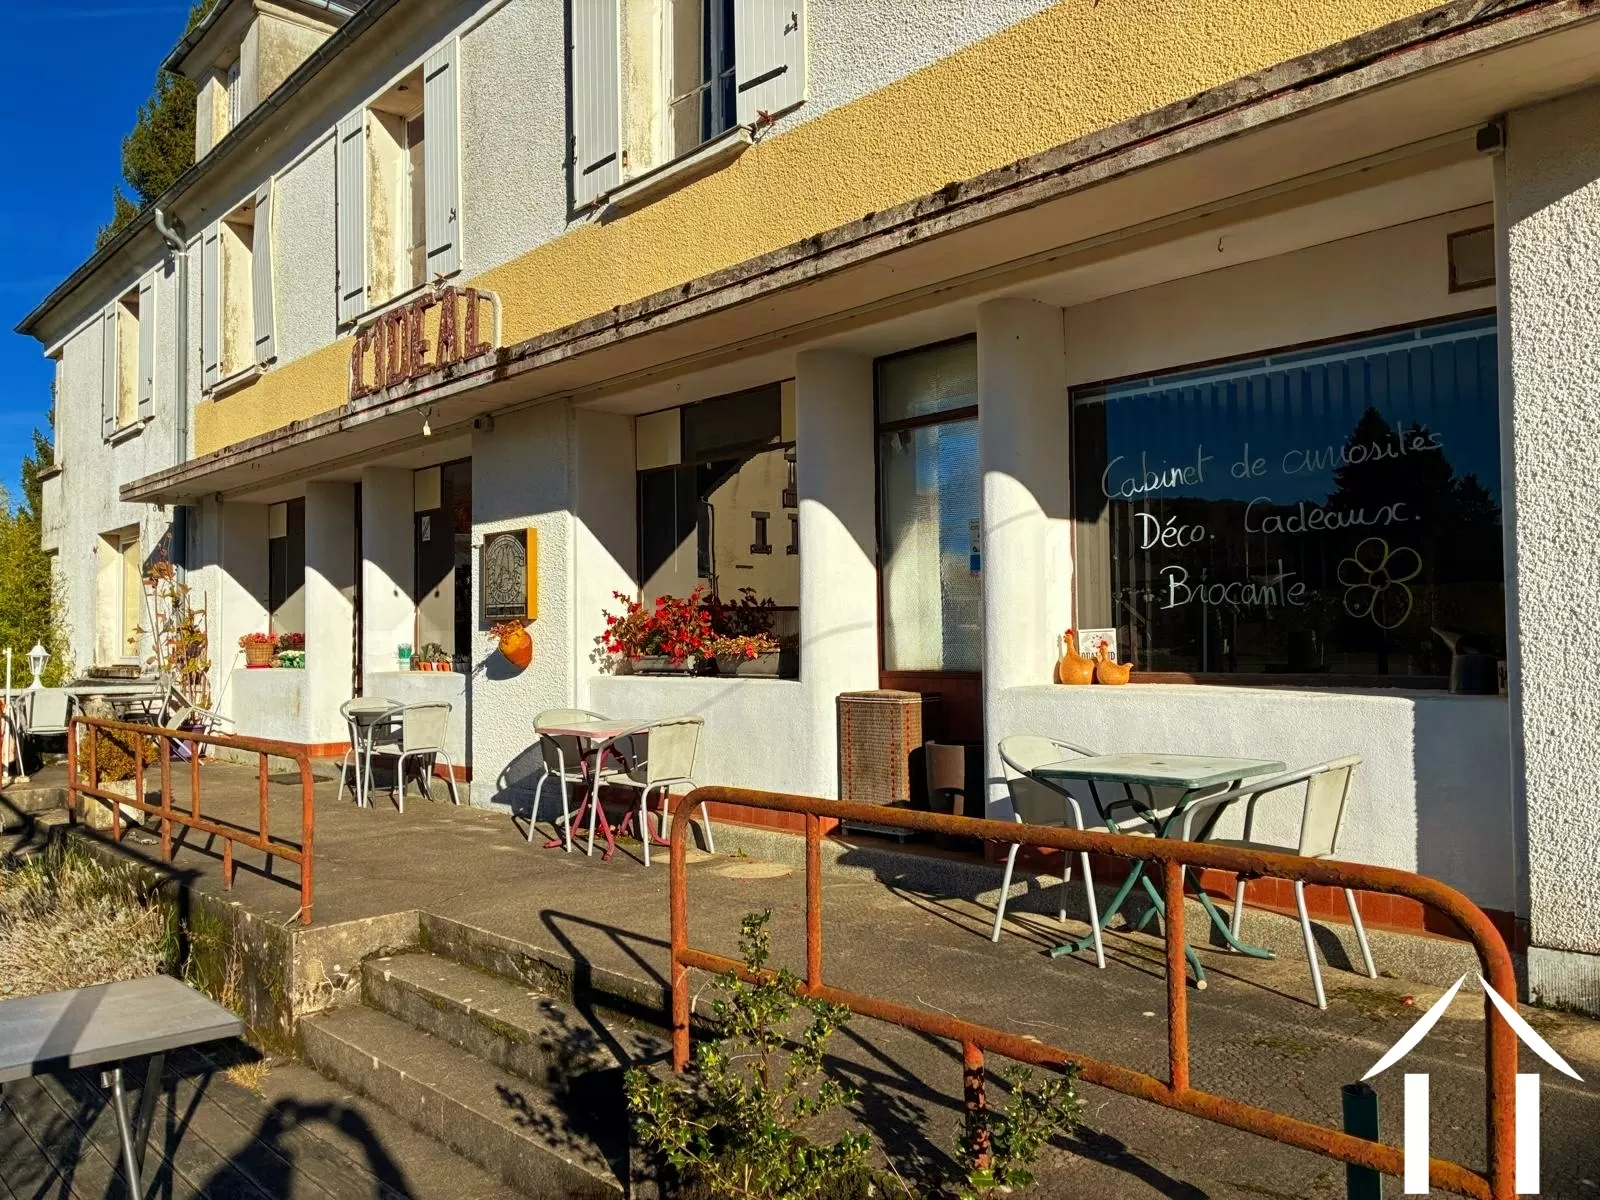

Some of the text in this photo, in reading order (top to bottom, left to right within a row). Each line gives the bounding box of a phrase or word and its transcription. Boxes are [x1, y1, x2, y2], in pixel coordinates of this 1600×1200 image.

[1102, 421, 1444, 497] Cabinet de curiosités
[1134, 496, 1421, 549] Déco. Cadeaux.
[1160, 559, 1306, 610] Brocante
